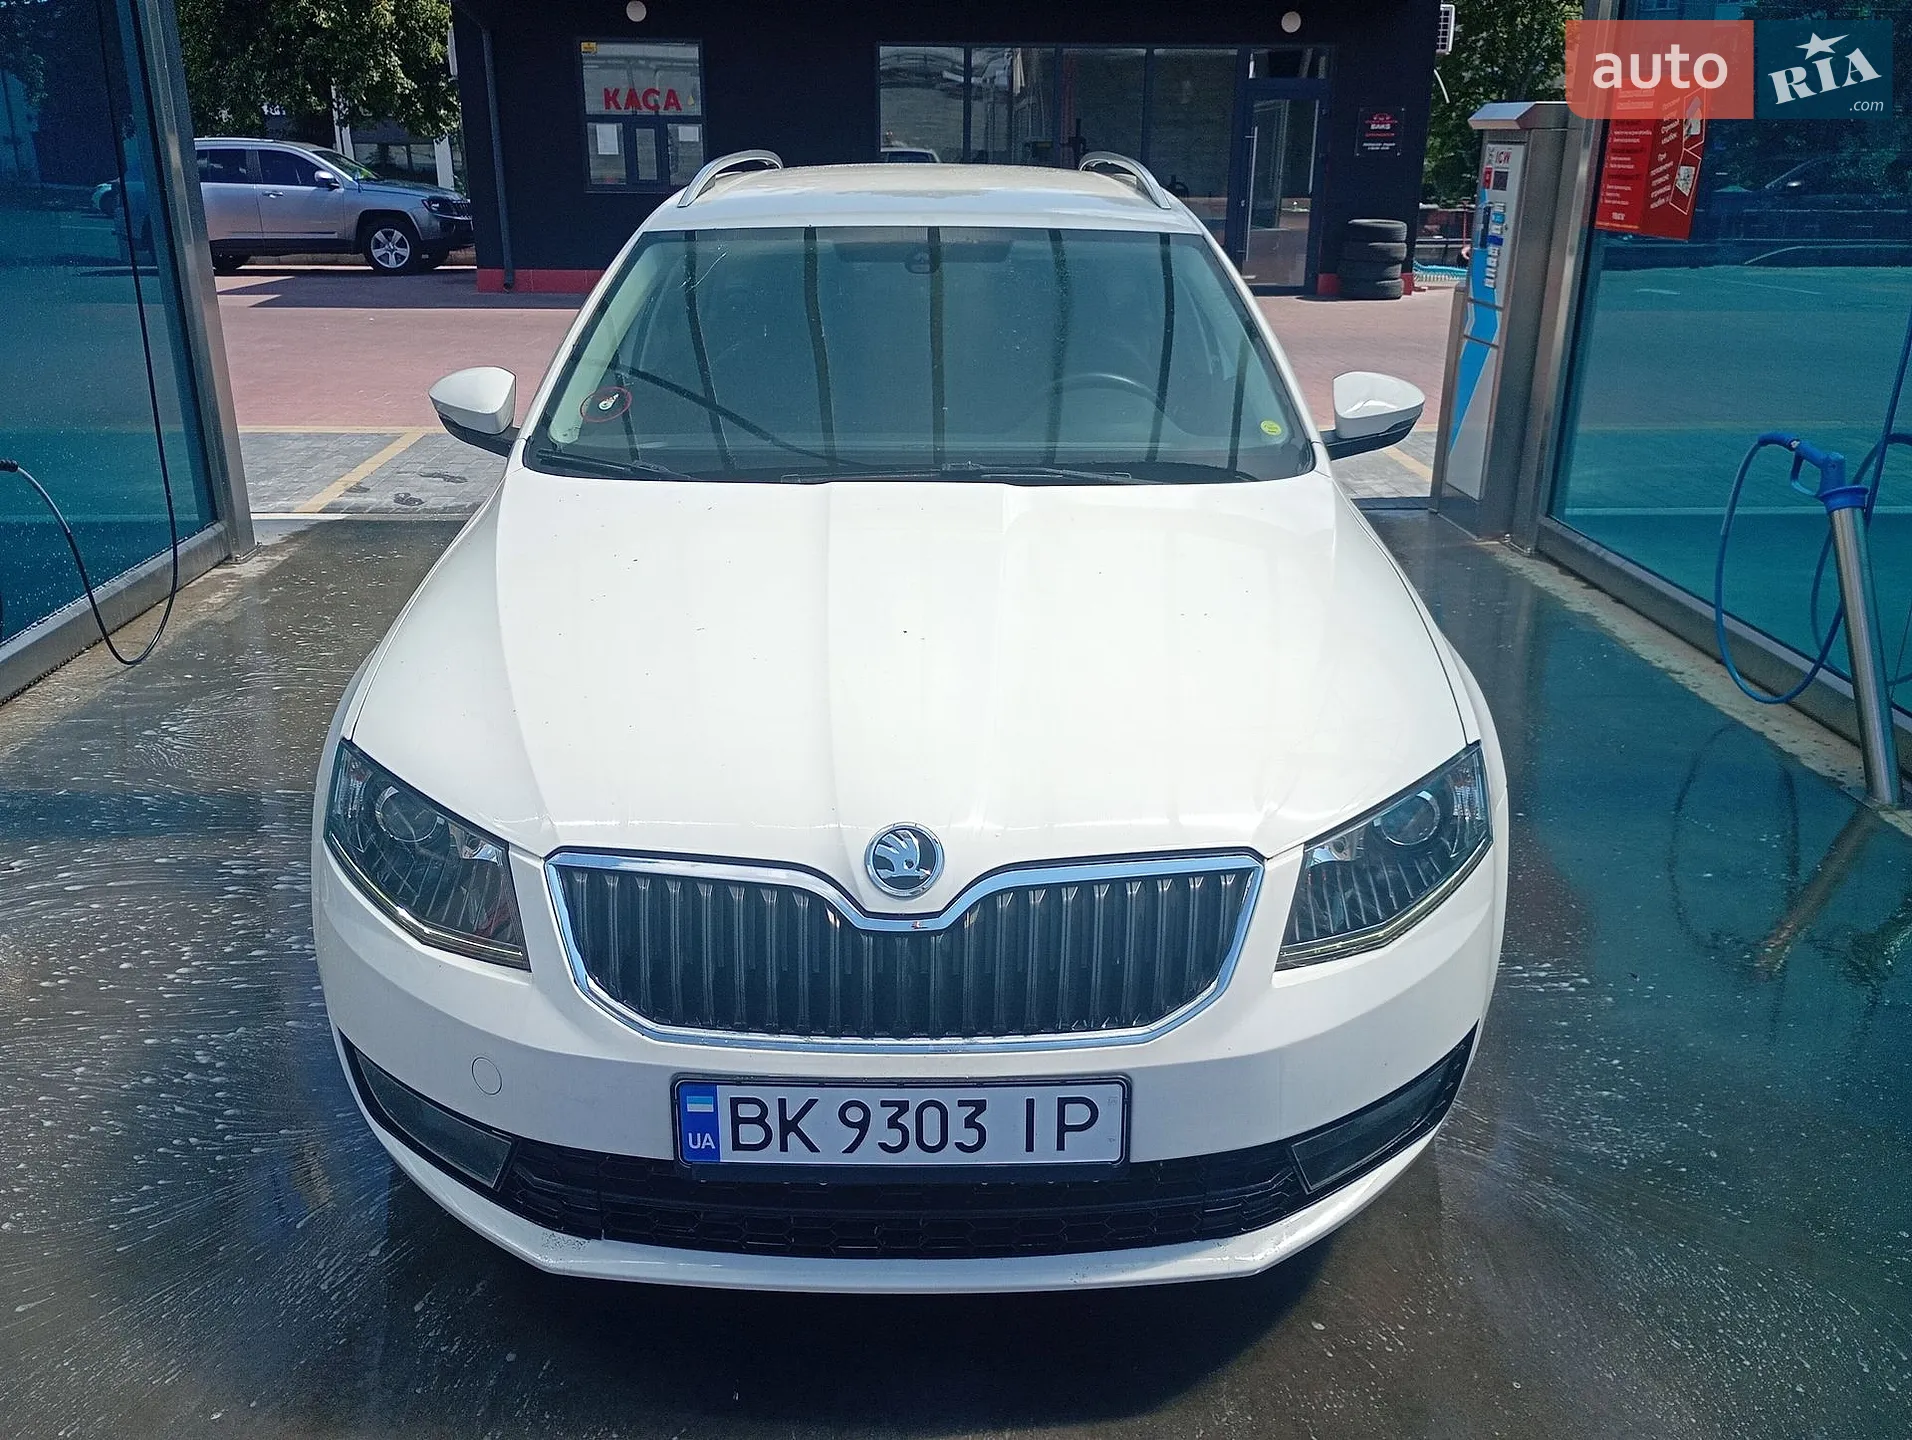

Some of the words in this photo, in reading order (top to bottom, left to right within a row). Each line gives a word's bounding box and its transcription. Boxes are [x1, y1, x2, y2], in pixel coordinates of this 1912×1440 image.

[603, 87, 682, 112] КАСА
[729, 1097, 821, 1152] BK
[837, 1098, 988, 1154] 9303
[1024, 1096, 1100, 1152] IP
[688, 1132, 716, 1150] UA
